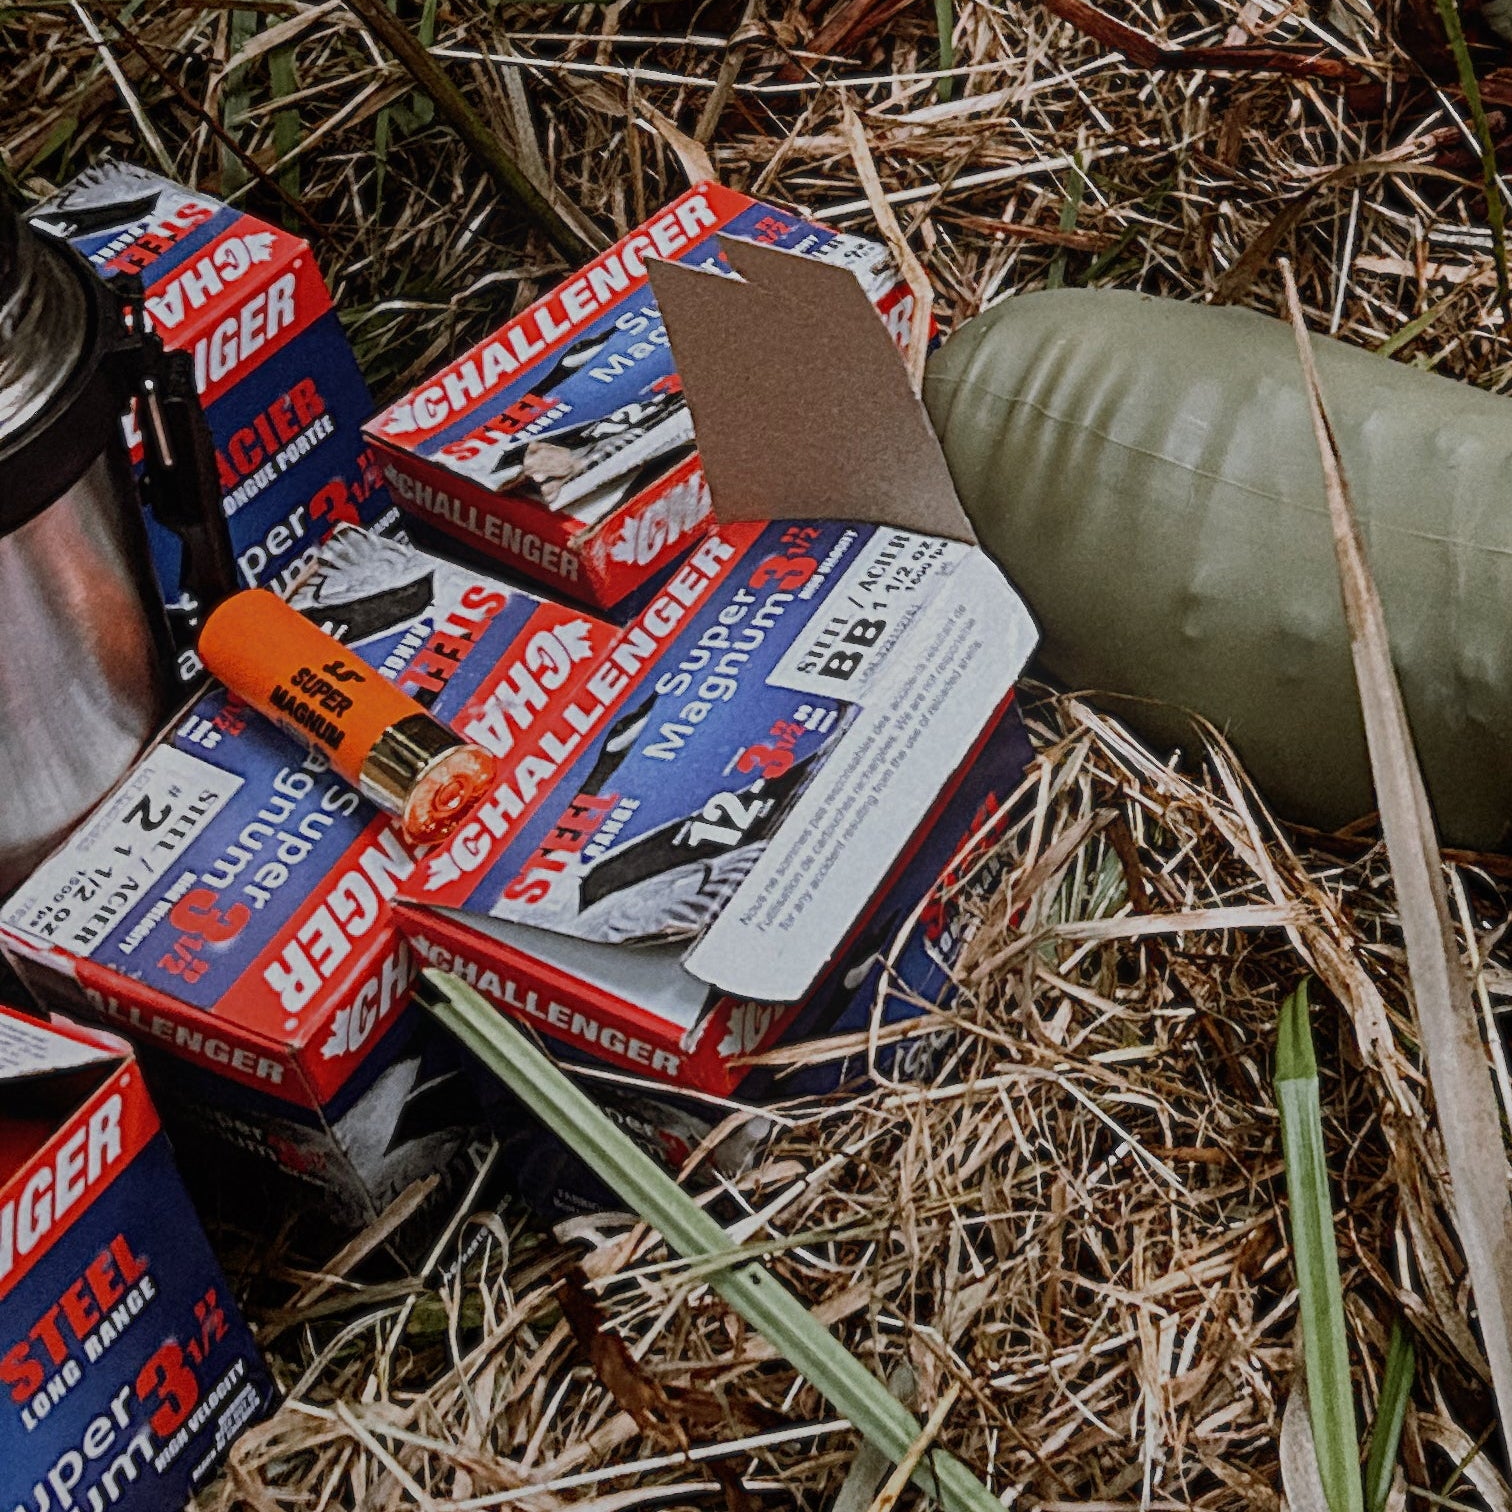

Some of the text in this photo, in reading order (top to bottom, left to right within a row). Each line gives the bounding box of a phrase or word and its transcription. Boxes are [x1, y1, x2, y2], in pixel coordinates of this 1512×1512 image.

[144, 236, 252, 328] CHA
[194, 273, 297, 394] GER
[410, 196, 718, 438] CHALLENGER
[214, 376, 325, 486] ACIER
[222, 448, 282, 516] ONGUE
[237, 501, 306, 589] per
[400, 472, 582, 582] CHALLENGER
[636, 468, 716, 568] CH
[290, 666, 354, 720] SUPER
[465, 618, 572, 758] CHA
[642, 590, 797, 764] Magnum
[655, 586, 757, 698] Super
[817, 617, 887, 682] BB
[269, 684, 346, 752] MAGNUM
[450, 536, 737, 882] CHALLENGER
[123, 794, 173, 832] 2
[202, 742, 330, 893] agnum
[254, 784, 359, 910] Super
[264, 823, 420, 1014] NGER
[738, 892, 766, 926] Nous
[761, 875, 778, 894] ne
[85, 988, 285, 1084] ALLENGER
[345, 950, 414, 1041] CH
[433, 946, 682, 1076] CHALLENGER
[0, 1233, 148, 1404] STEEL
[21, 1359, 82, 1432] LONG
[84, 1275, 157, 1363] RANGE
[14, 1385, 130, 1512] uper
